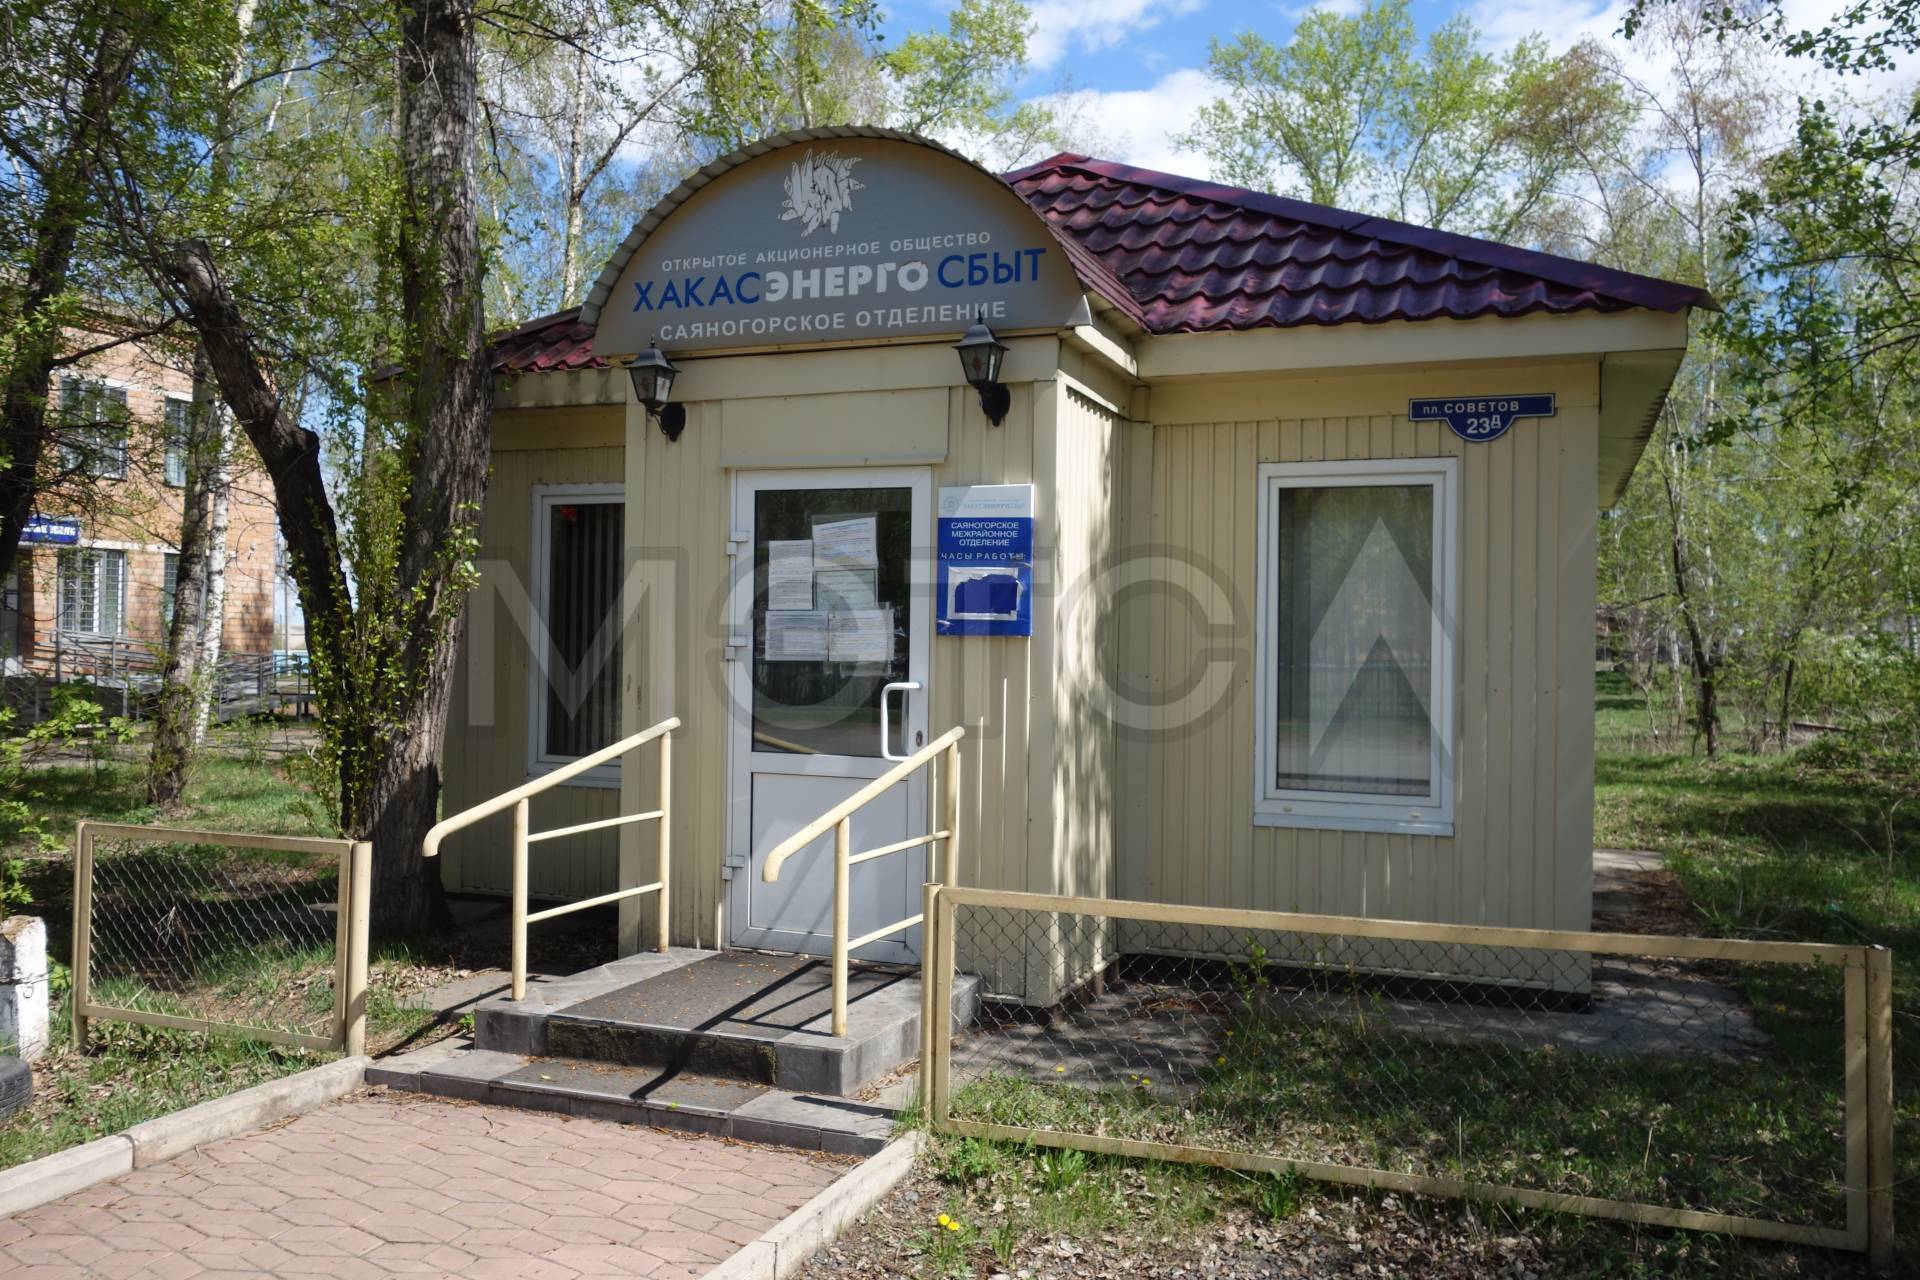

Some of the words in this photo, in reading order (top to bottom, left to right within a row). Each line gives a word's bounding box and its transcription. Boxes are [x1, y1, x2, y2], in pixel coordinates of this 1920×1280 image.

[661, 252, 748, 272] ОТКРЫТОЕ
[755, 241, 881, 264] АКЦИОНЕРНОЕ
[890, 231, 991, 252] ОБЩЕСТВО
[660, 312, 846, 341] САЯНОГОРСКОЕ
[855, 300, 1006, 328] ОТДЕЛЕНИЕ
[1444, 400, 1520, 414] СОВЕТОВ
[951, 521, 1019, 530] САЯНОГОРСКОЕ
[951, 529, 1019, 538] МЕЖРАЙОННОЕ
[959, 539, 1010, 547] ОТДЕЛЕНИЕ
[941, 552, 973, 560] ЧАСЫ
